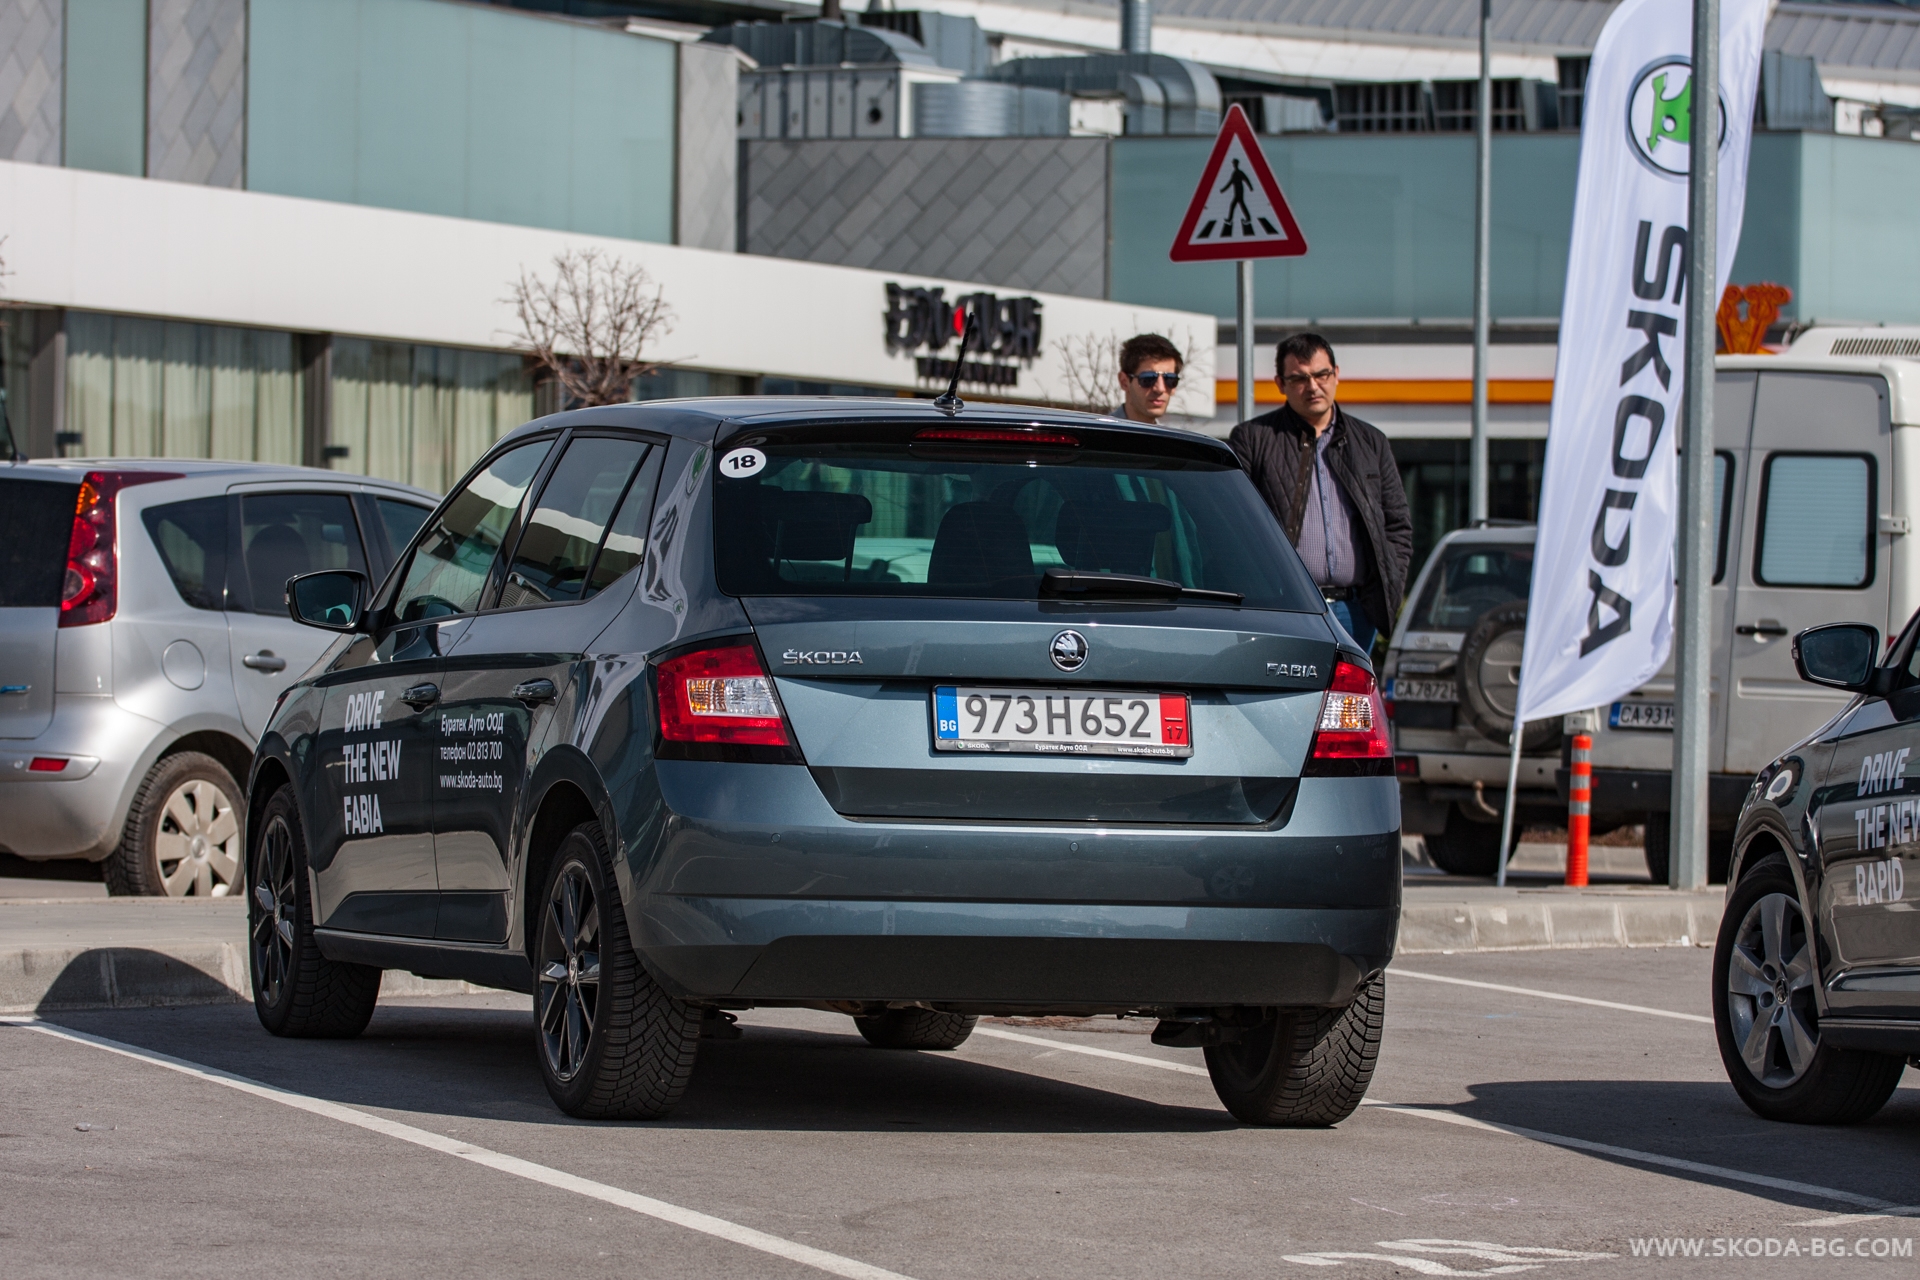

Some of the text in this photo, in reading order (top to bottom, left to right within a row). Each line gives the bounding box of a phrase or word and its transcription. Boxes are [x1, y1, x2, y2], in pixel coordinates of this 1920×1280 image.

[728, 454, 757, 470] 18
[782, 648, 863, 665] ŠKODA
[1266, 662, 1318, 679] FABIA
[344, 690, 385, 733] DRIVE
[441, 712, 504, 736] Еуратек Ауто ООД
[940, 719, 957, 732] BG
[1166, 725, 1184, 739] 17
[440, 741, 503, 765] телефон 02 813 700
[1035, 744, 1059, 752] Еуратек
[1059, 744, 1074, 752] Ауто
[1117, 746, 1175, 756] www.skoda-auto.bg
[343, 739, 402, 783] THE NEW
[1857, 747, 1911, 797] DRIVE
[440, 770, 503, 793] www.skoda-auto.bg
[343, 793, 384, 835] FABIA
[1855, 805, 1886, 851] THE
[1856, 860, 1904, 906] RAPID
